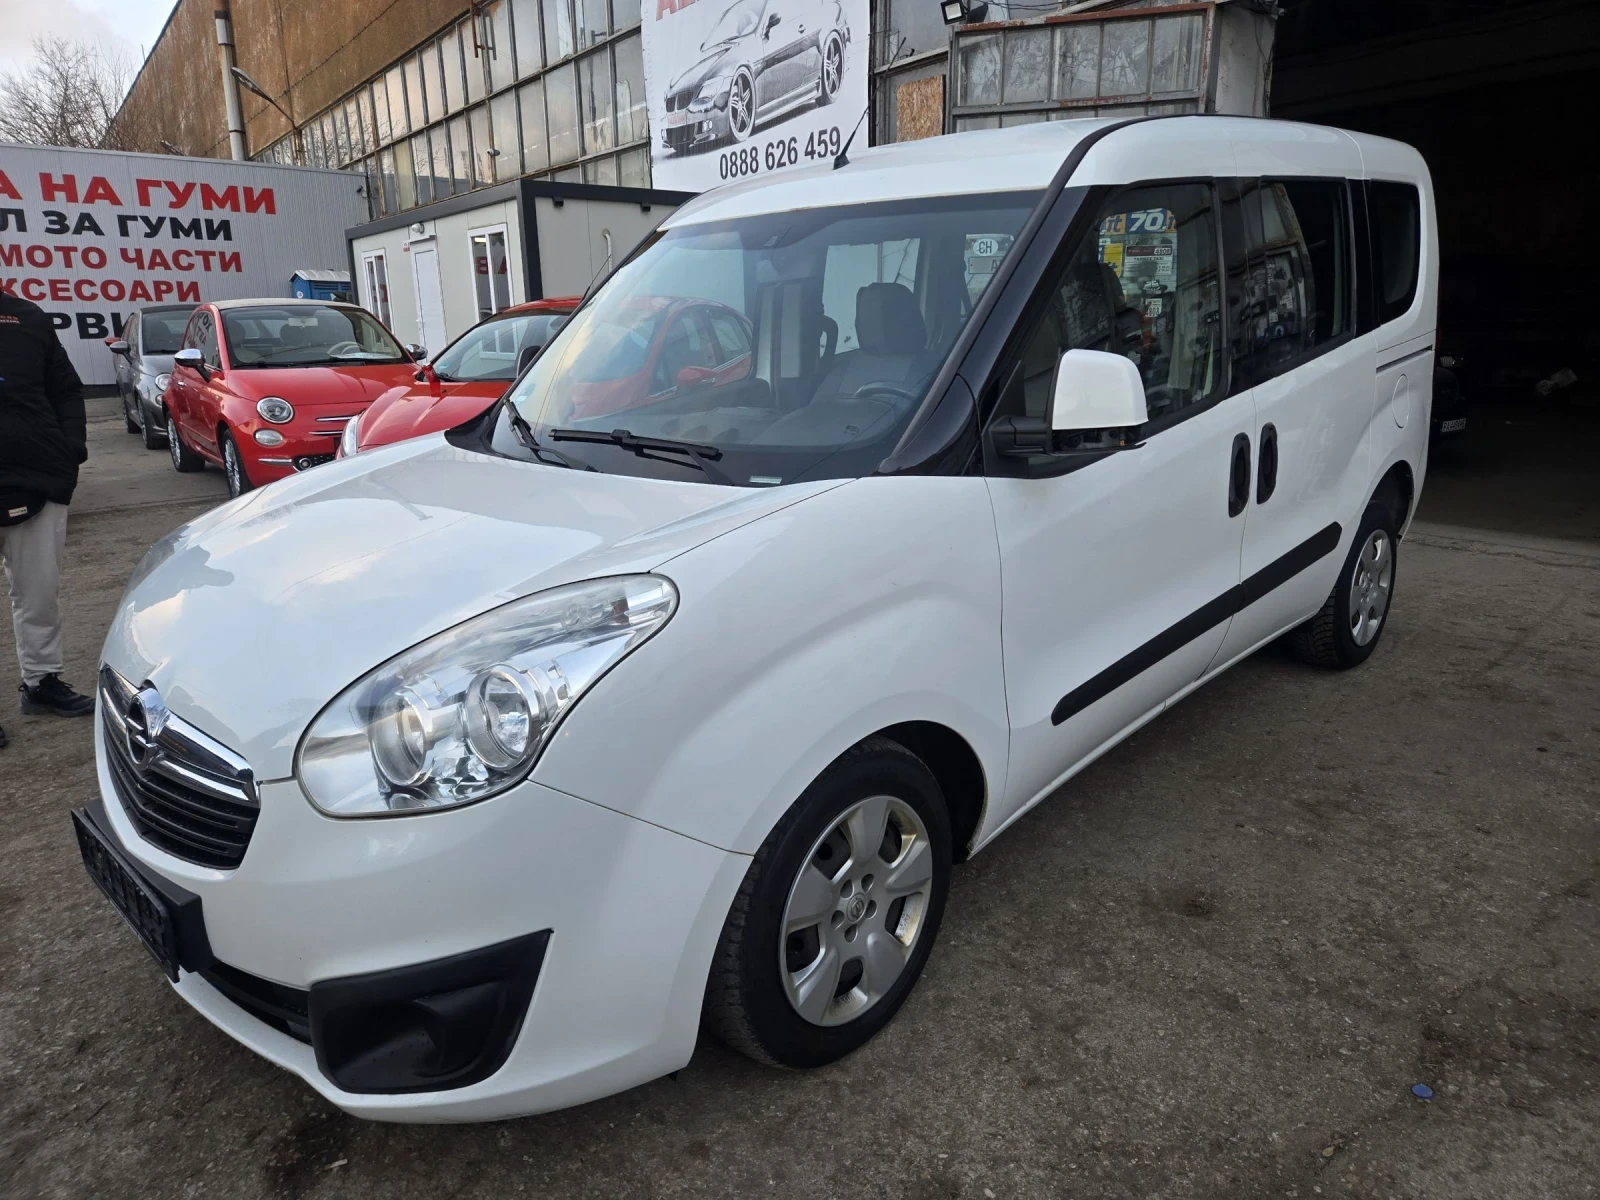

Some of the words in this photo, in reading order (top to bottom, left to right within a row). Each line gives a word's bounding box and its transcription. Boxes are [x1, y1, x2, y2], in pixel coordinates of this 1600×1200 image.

[719, 146, 760, 180] 0888
[765, 137, 798, 171] 626
[804, 126, 841, 161] 459
[39, 172, 123, 206] НА
[136, 178, 277, 215] ГУМИ
[42, 210, 105, 236] ЗА
[117, 214, 233, 241] ГУМИ
[0, 243, 107, 269] МОТО
[120, 248, 243, 273] ЧАСТИ
[978, 240, 993, 254] CH
[0, 277, 201, 302] КСЕСОАРИ
